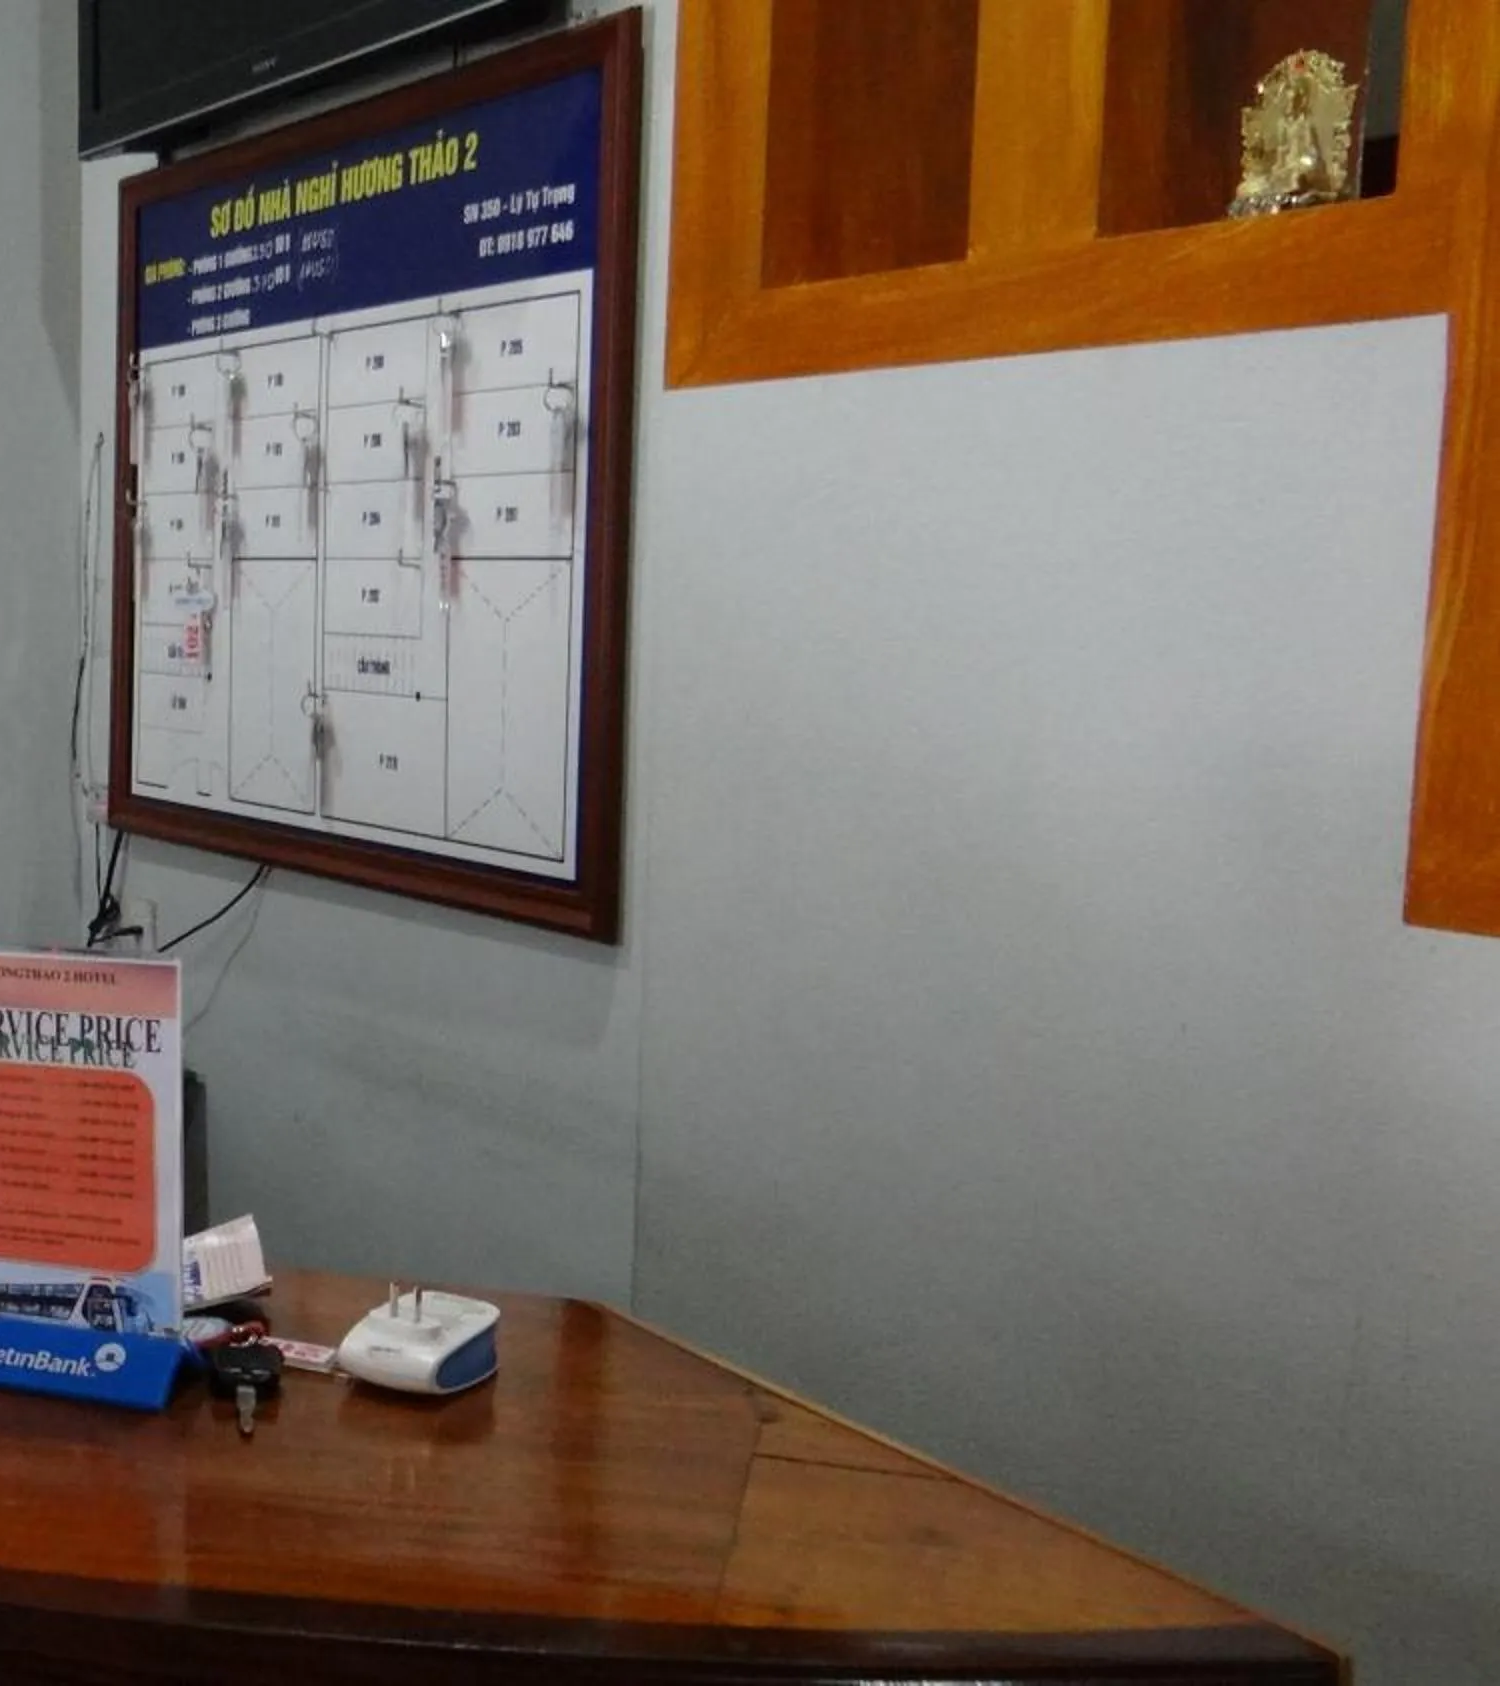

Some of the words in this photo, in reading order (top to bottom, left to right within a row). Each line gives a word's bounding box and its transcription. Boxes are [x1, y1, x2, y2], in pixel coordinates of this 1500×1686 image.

[210, 201, 231, 238] SƠ
[234, 183, 255, 232] ĐỒ
[258, 178, 291, 225] NHÀ
[295, 160, 339, 216] NGHỈ
[340, 152, 403, 204] HƯƠNG
[409, 129, 459, 186] THẢO
[463, 131, 479, 172] 2
[69, 1036, 138, 1069] PRICE
[79, 1013, 163, 1053] PRICE
